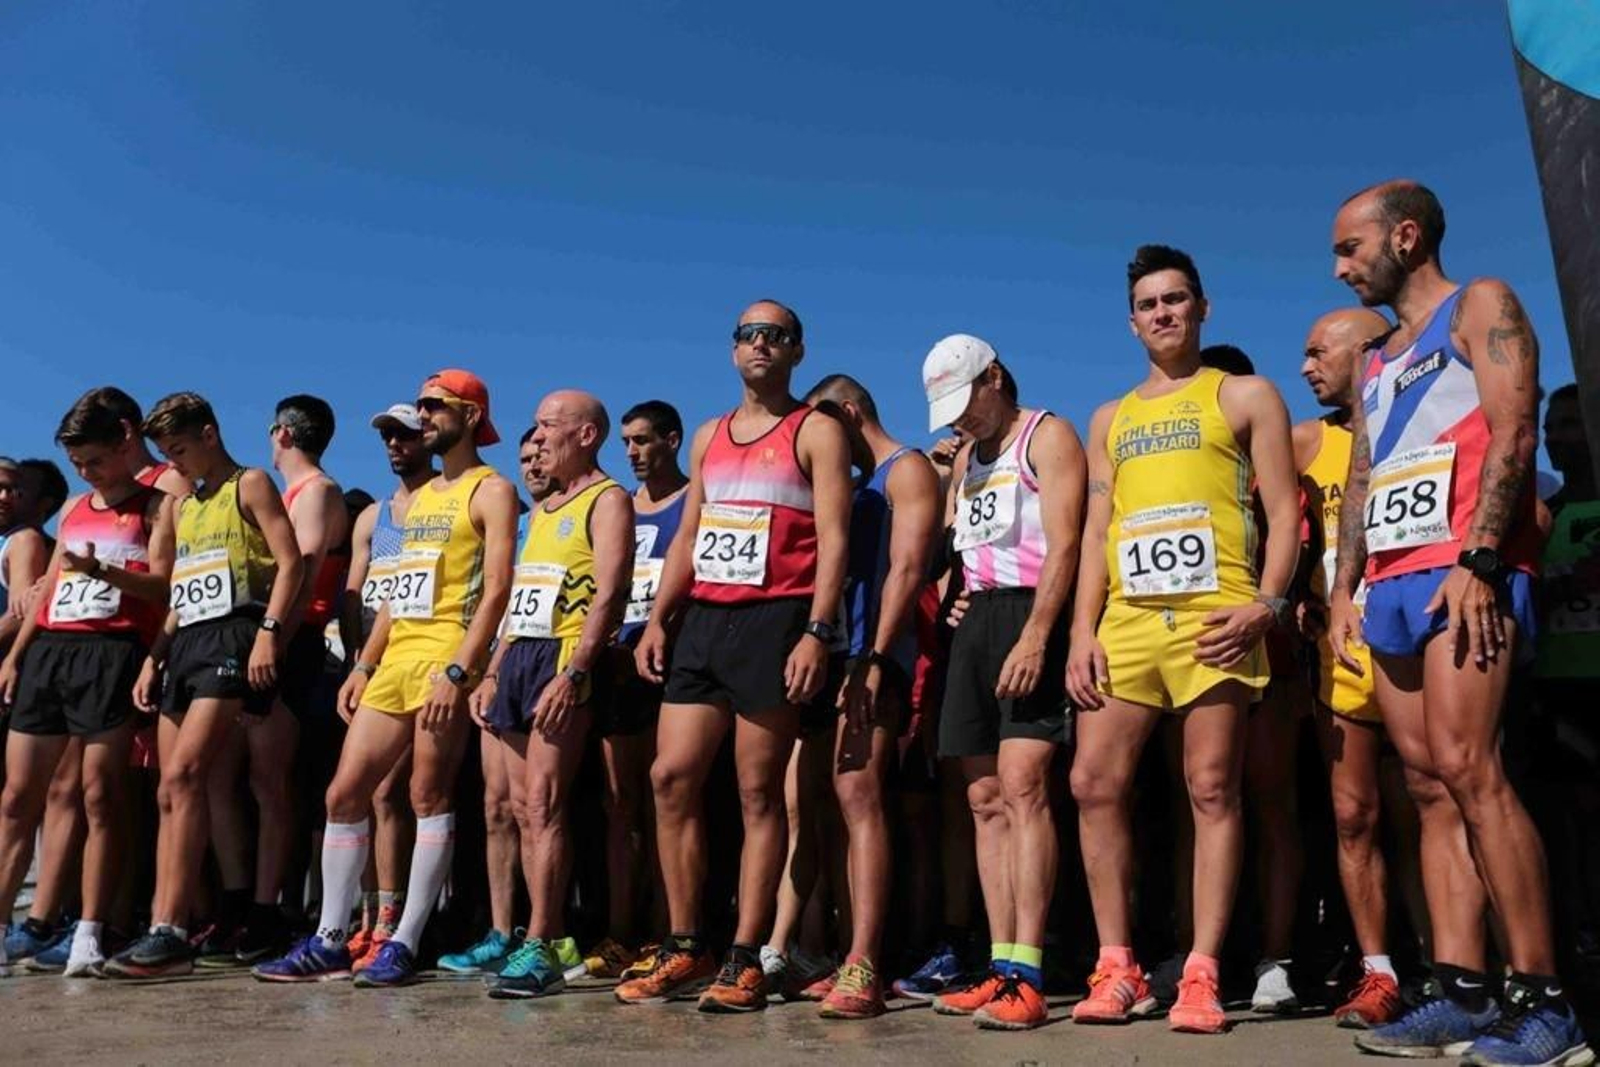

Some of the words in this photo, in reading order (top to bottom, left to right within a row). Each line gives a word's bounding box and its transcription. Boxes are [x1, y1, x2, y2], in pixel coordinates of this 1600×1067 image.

[1397, 351, 1441, 390] Toscaf
[1115, 417, 1200, 447] ATHLETICS
[1114, 440, 1137, 465] SAN
[969, 491, 997, 526] 83
[1365, 479, 1437, 529] 158
[699, 531, 758, 564] 234
[1127, 533, 1206, 577] 169
[57, 578, 113, 606] 272
[173, 573, 223, 609] 269
[390, 572, 428, 600] 237
[511, 588, 541, 616] 15
